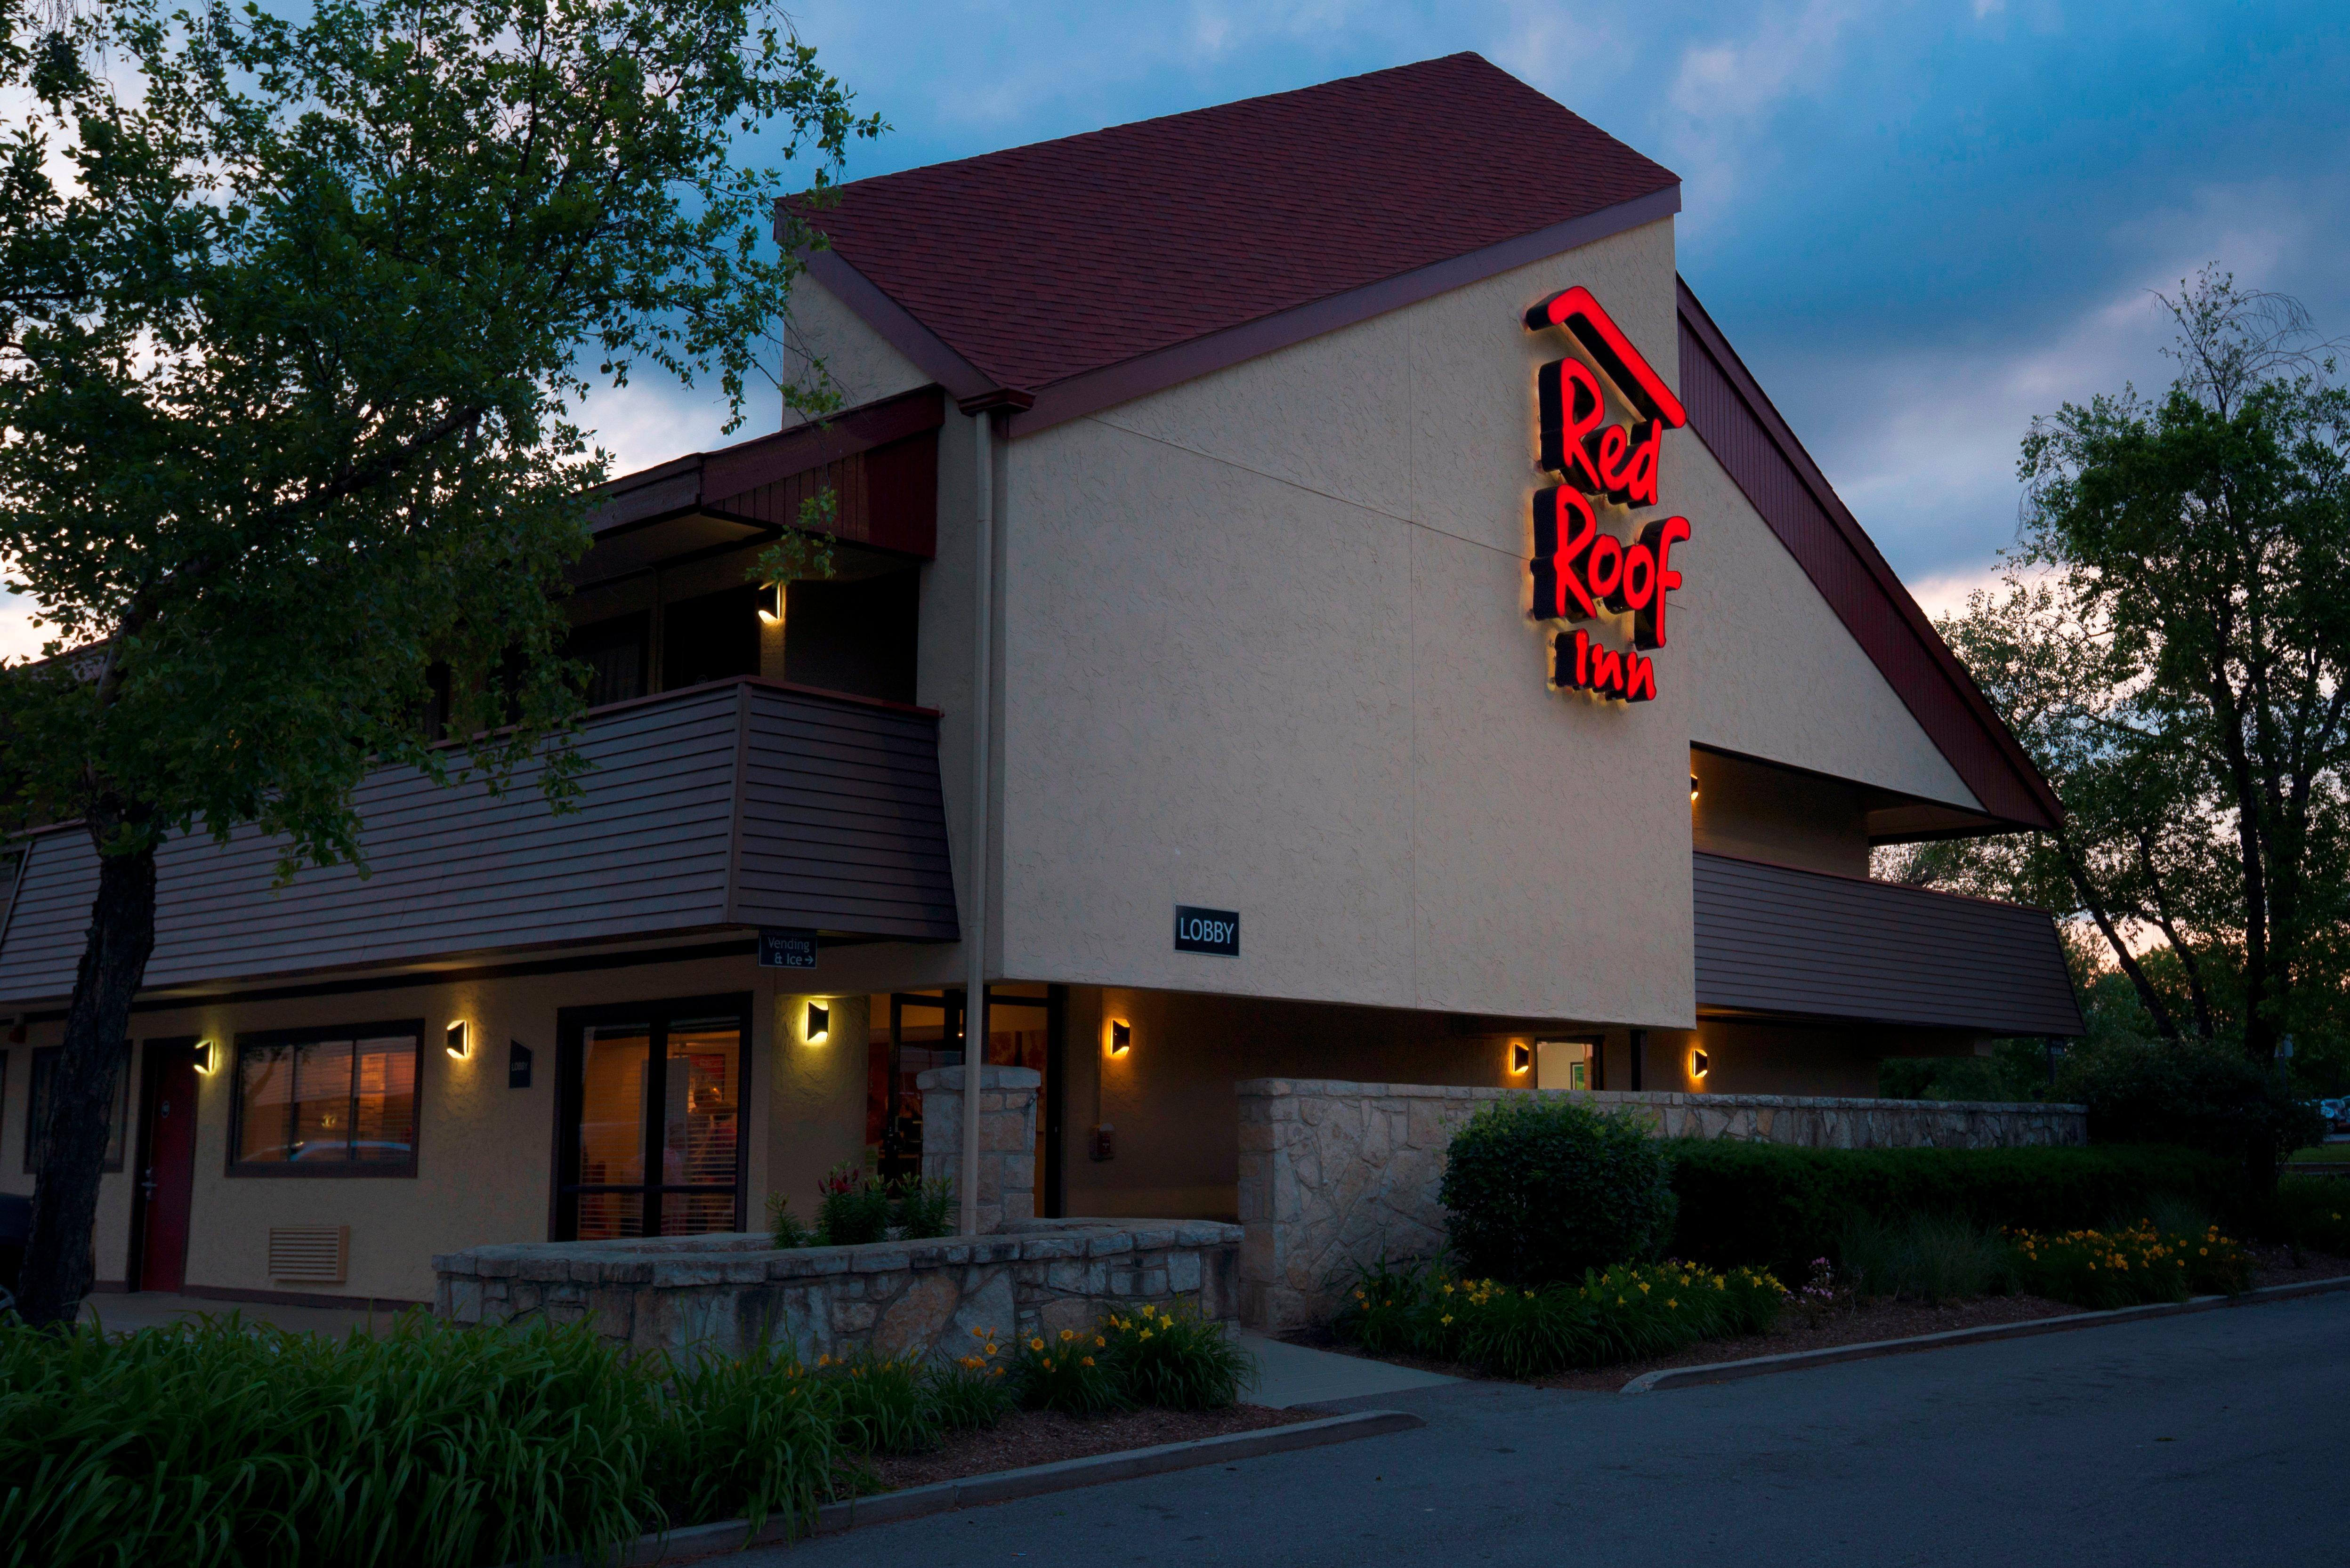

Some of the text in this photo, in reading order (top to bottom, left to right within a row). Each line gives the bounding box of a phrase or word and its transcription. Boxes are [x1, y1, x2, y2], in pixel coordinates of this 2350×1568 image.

[1561, 357, 1662, 506] Red
[1553, 484, 1691, 649] Roof
[1576, 628, 1656, 701] Inn
[768, 936, 810, 953] Vending
[1180, 917, 1234, 944] LOBBY
[775, 952, 803, 965] & Ice
